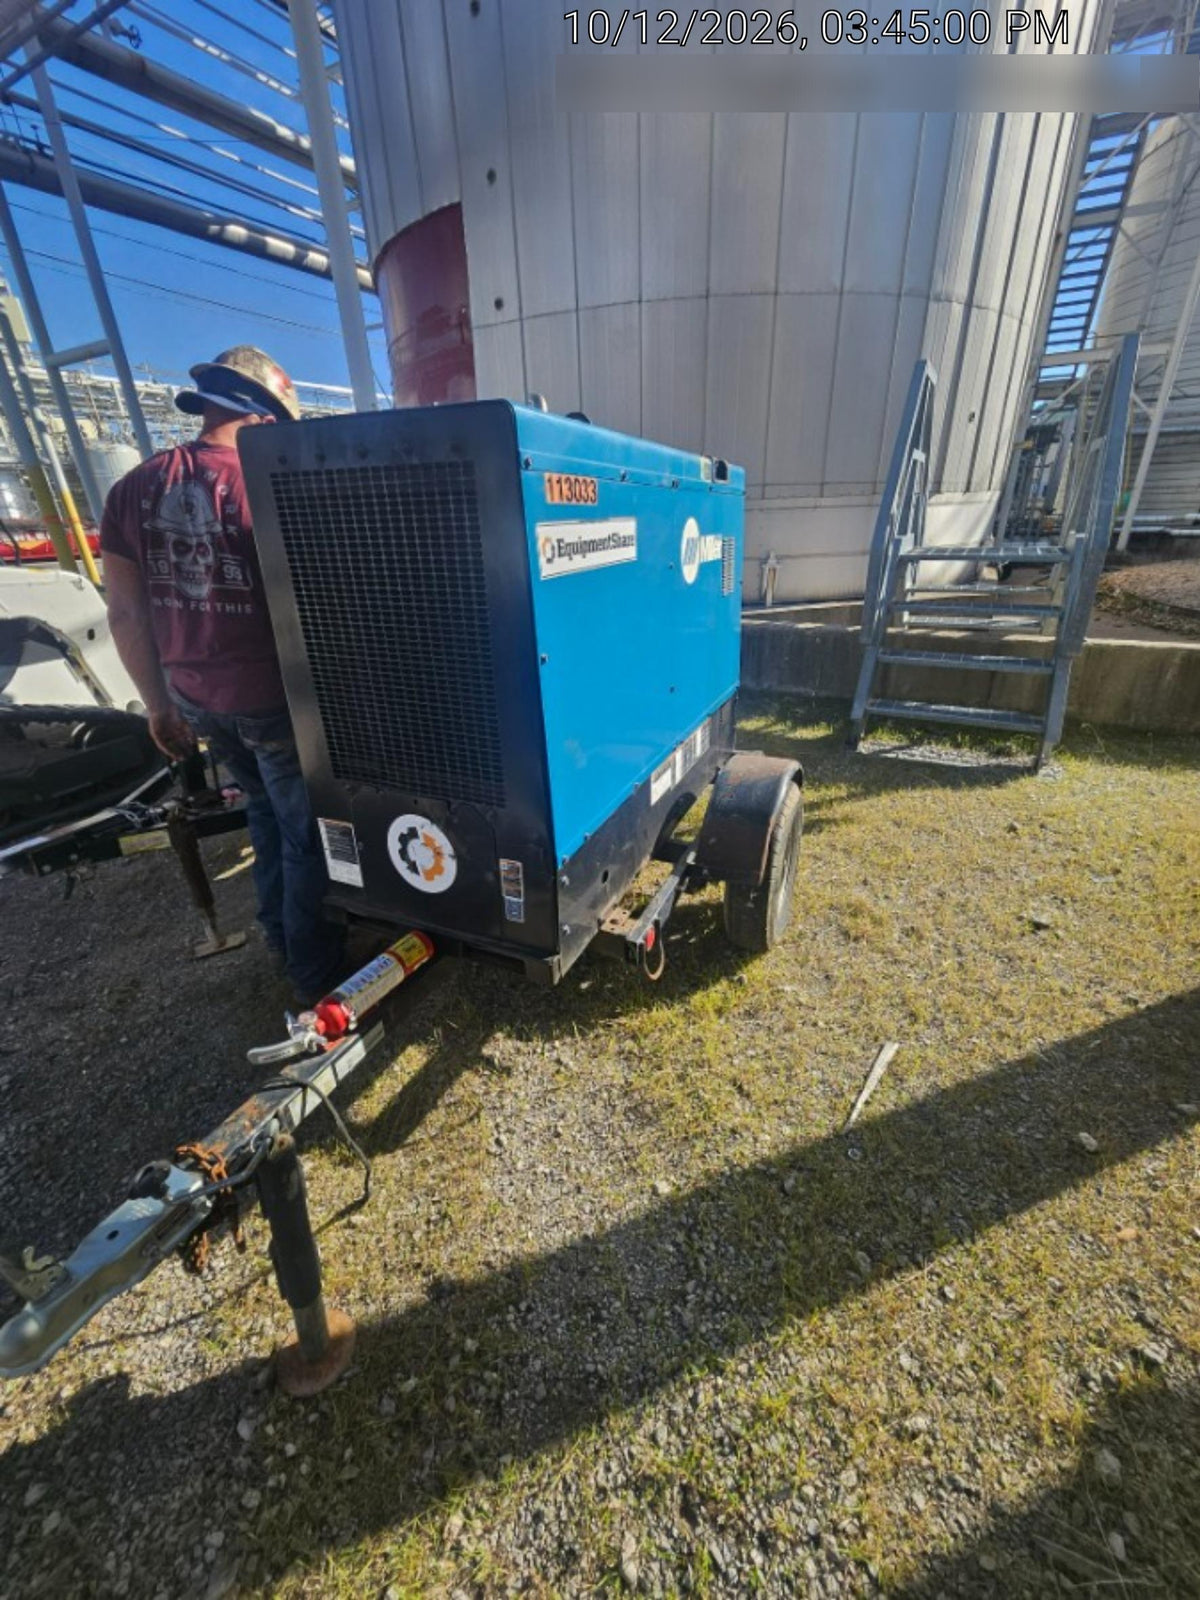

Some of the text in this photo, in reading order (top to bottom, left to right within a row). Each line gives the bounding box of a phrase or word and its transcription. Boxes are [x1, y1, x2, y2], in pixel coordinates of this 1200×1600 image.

[547, 473, 597, 504] 113033
[556, 532, 635, 561] EquipmentShare
[215, 601, 252, 614] THIS
